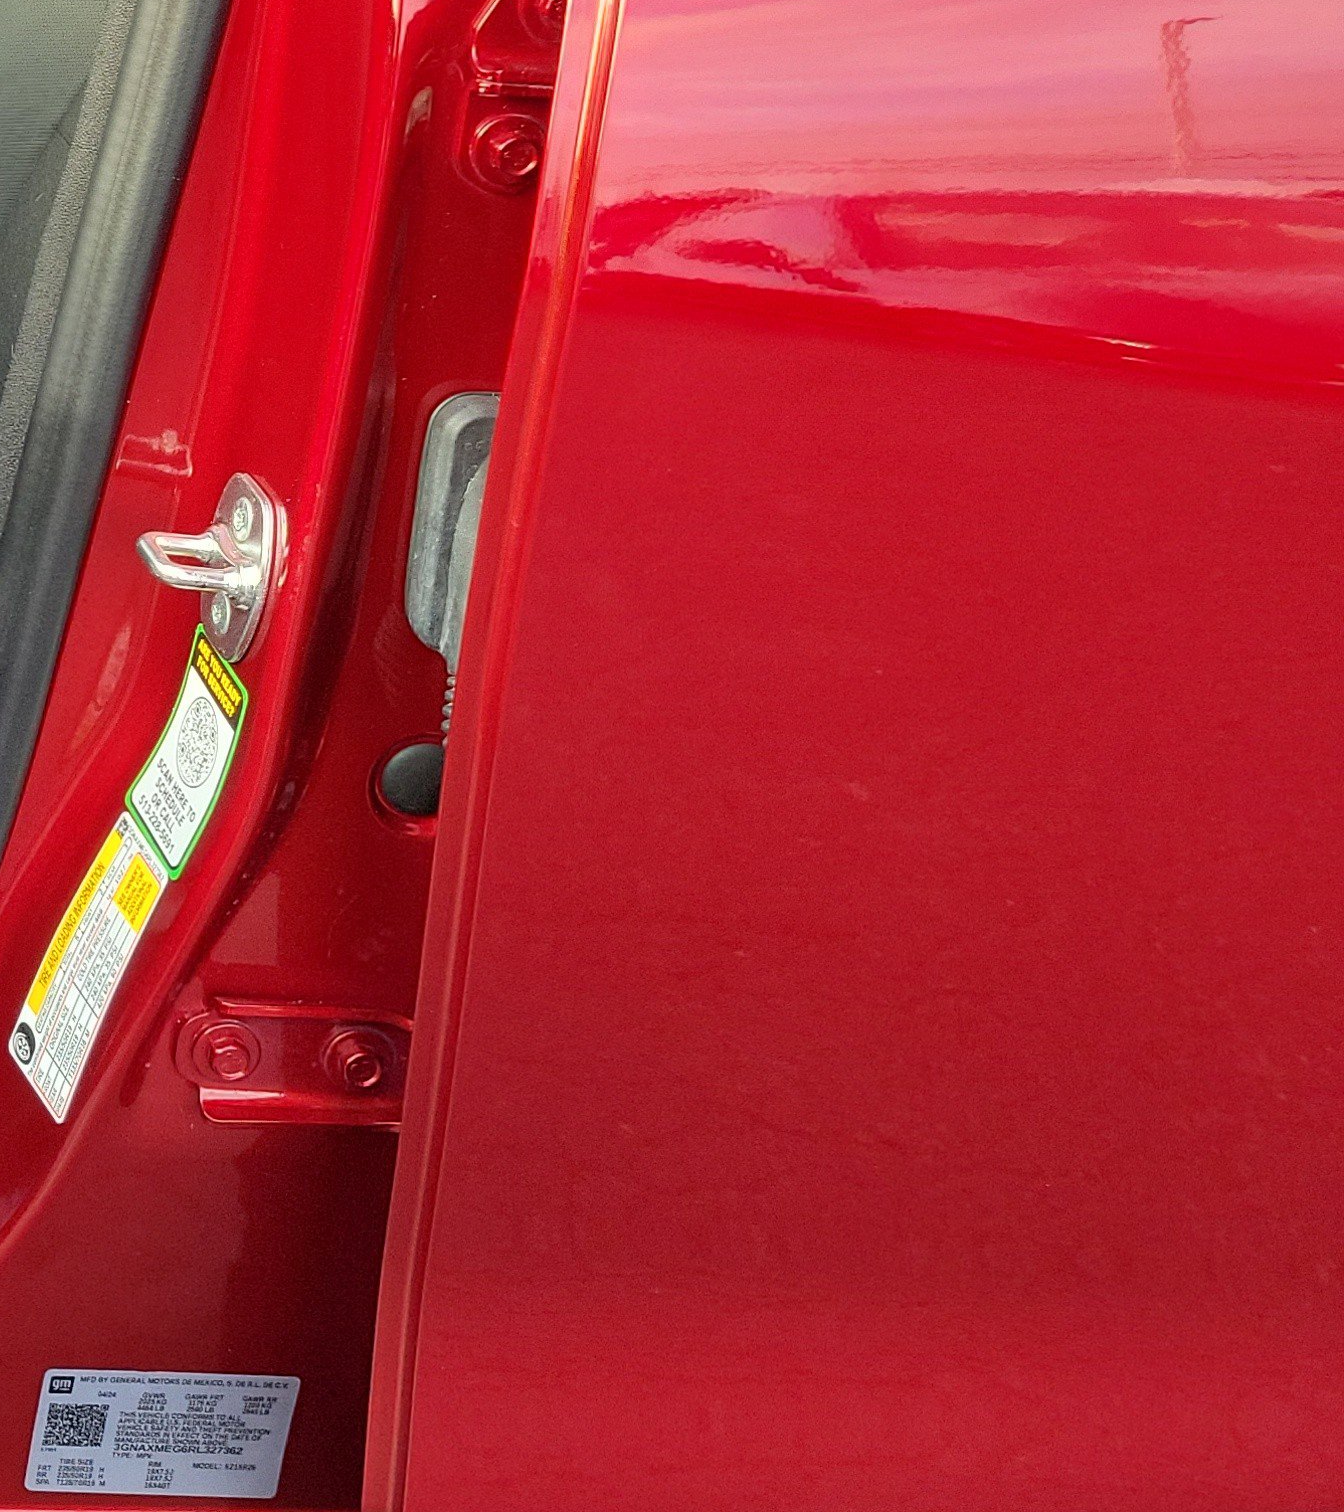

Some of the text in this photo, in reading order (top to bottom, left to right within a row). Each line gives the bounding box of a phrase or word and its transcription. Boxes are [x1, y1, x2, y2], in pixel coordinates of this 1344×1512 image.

[197, 655, 209, 679] FOR
[198, 639, 241, 706] ARE YOU READY
[155, 777, 185, 827] SCHEDULE
[157, 758, 196, 822] SCAN HERE TO
[151, 793, 175, 834] OR CALL
[73, 858, 105, 920] INFORMATION
[52, 1379, 71, 1390] gm
[148, 1377, 180, 1385] MOTORS
[113, 1444, 244, 1455] 3GNAXMEG6RL327362
